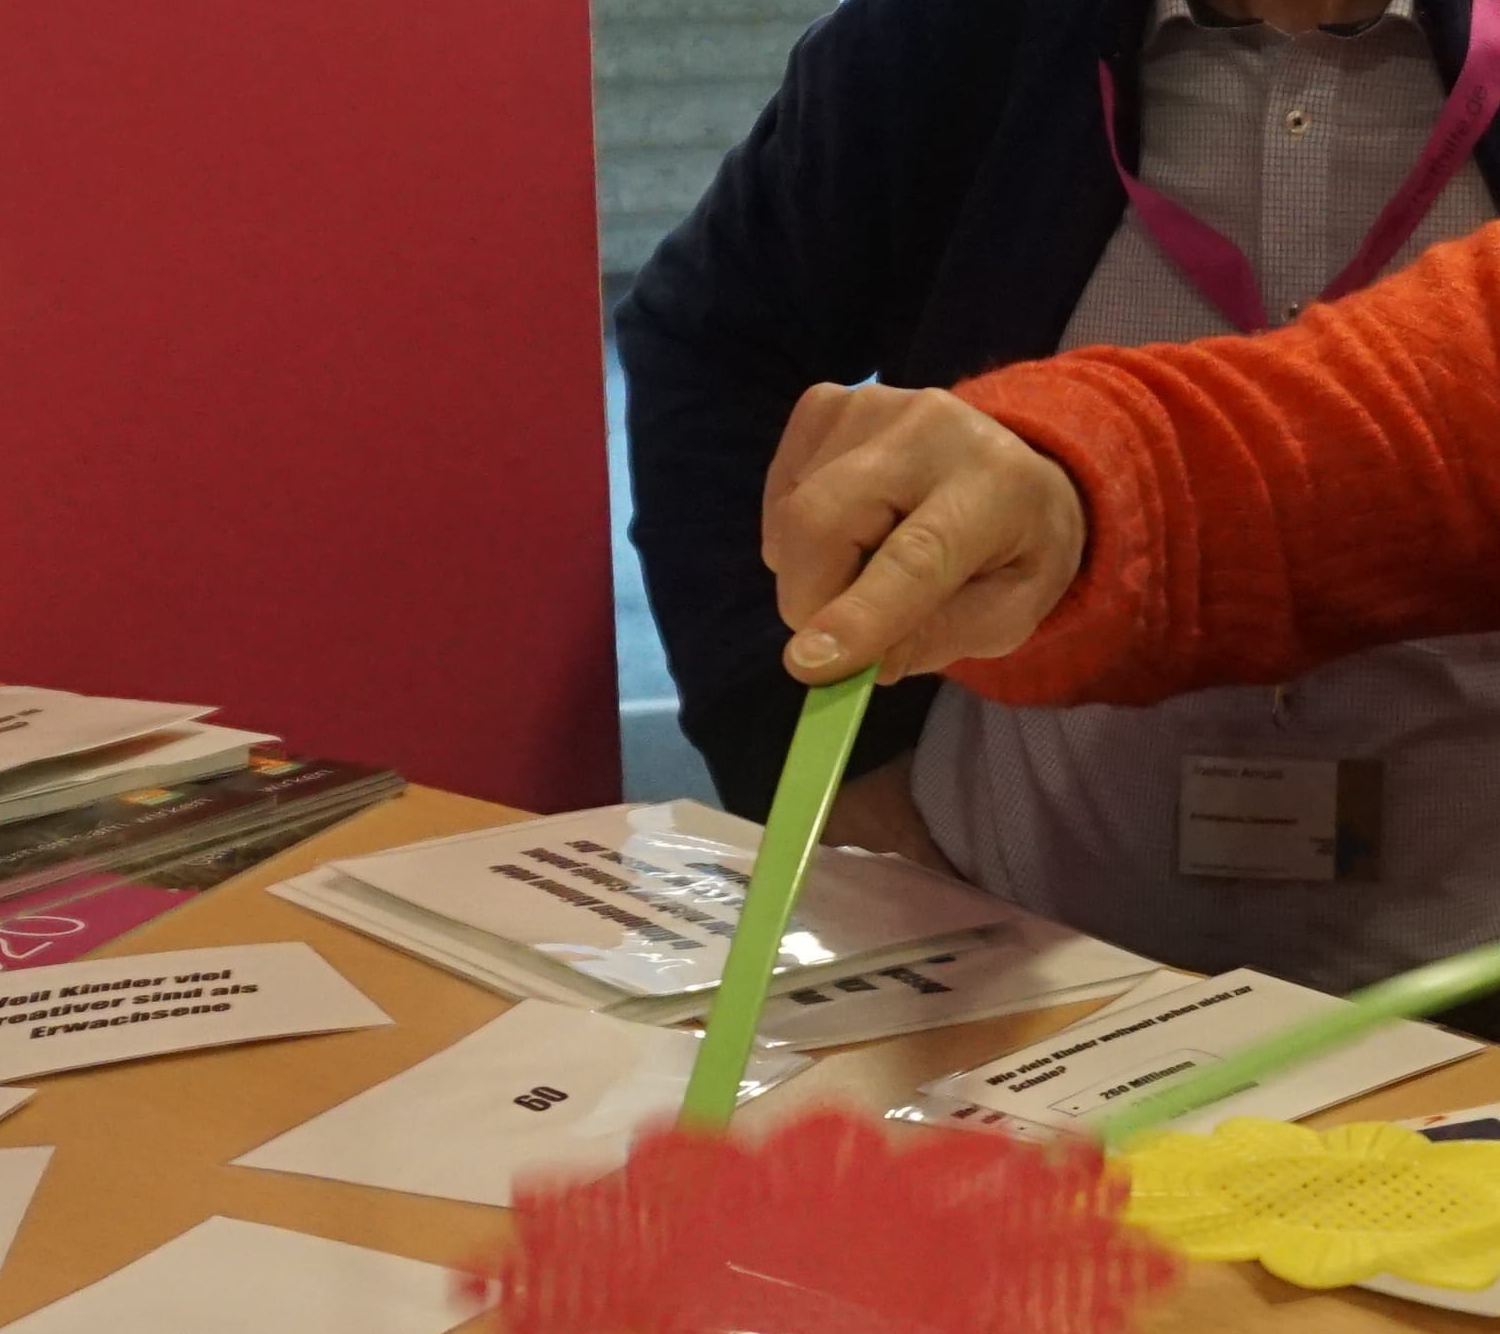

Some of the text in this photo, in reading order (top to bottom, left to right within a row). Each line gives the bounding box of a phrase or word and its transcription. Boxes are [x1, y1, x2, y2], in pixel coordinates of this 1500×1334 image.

[58, 974, 168, 1000] Kinder
[172, 968, 233, 985] viel
[132, 986, 204, 1006] sind
[209, 982, 260, 999] als
[29, 1000, 233, 1039] Erwachsene
[985, 984, 1253, 1087] Wie viele Kinder weltweit gehen nicht zur
[1008, 1065, 1067, 1093] Schule?
[1128, 1060, 1197, 1089] Millionen
[512, 1084, 570, 1113] 60
